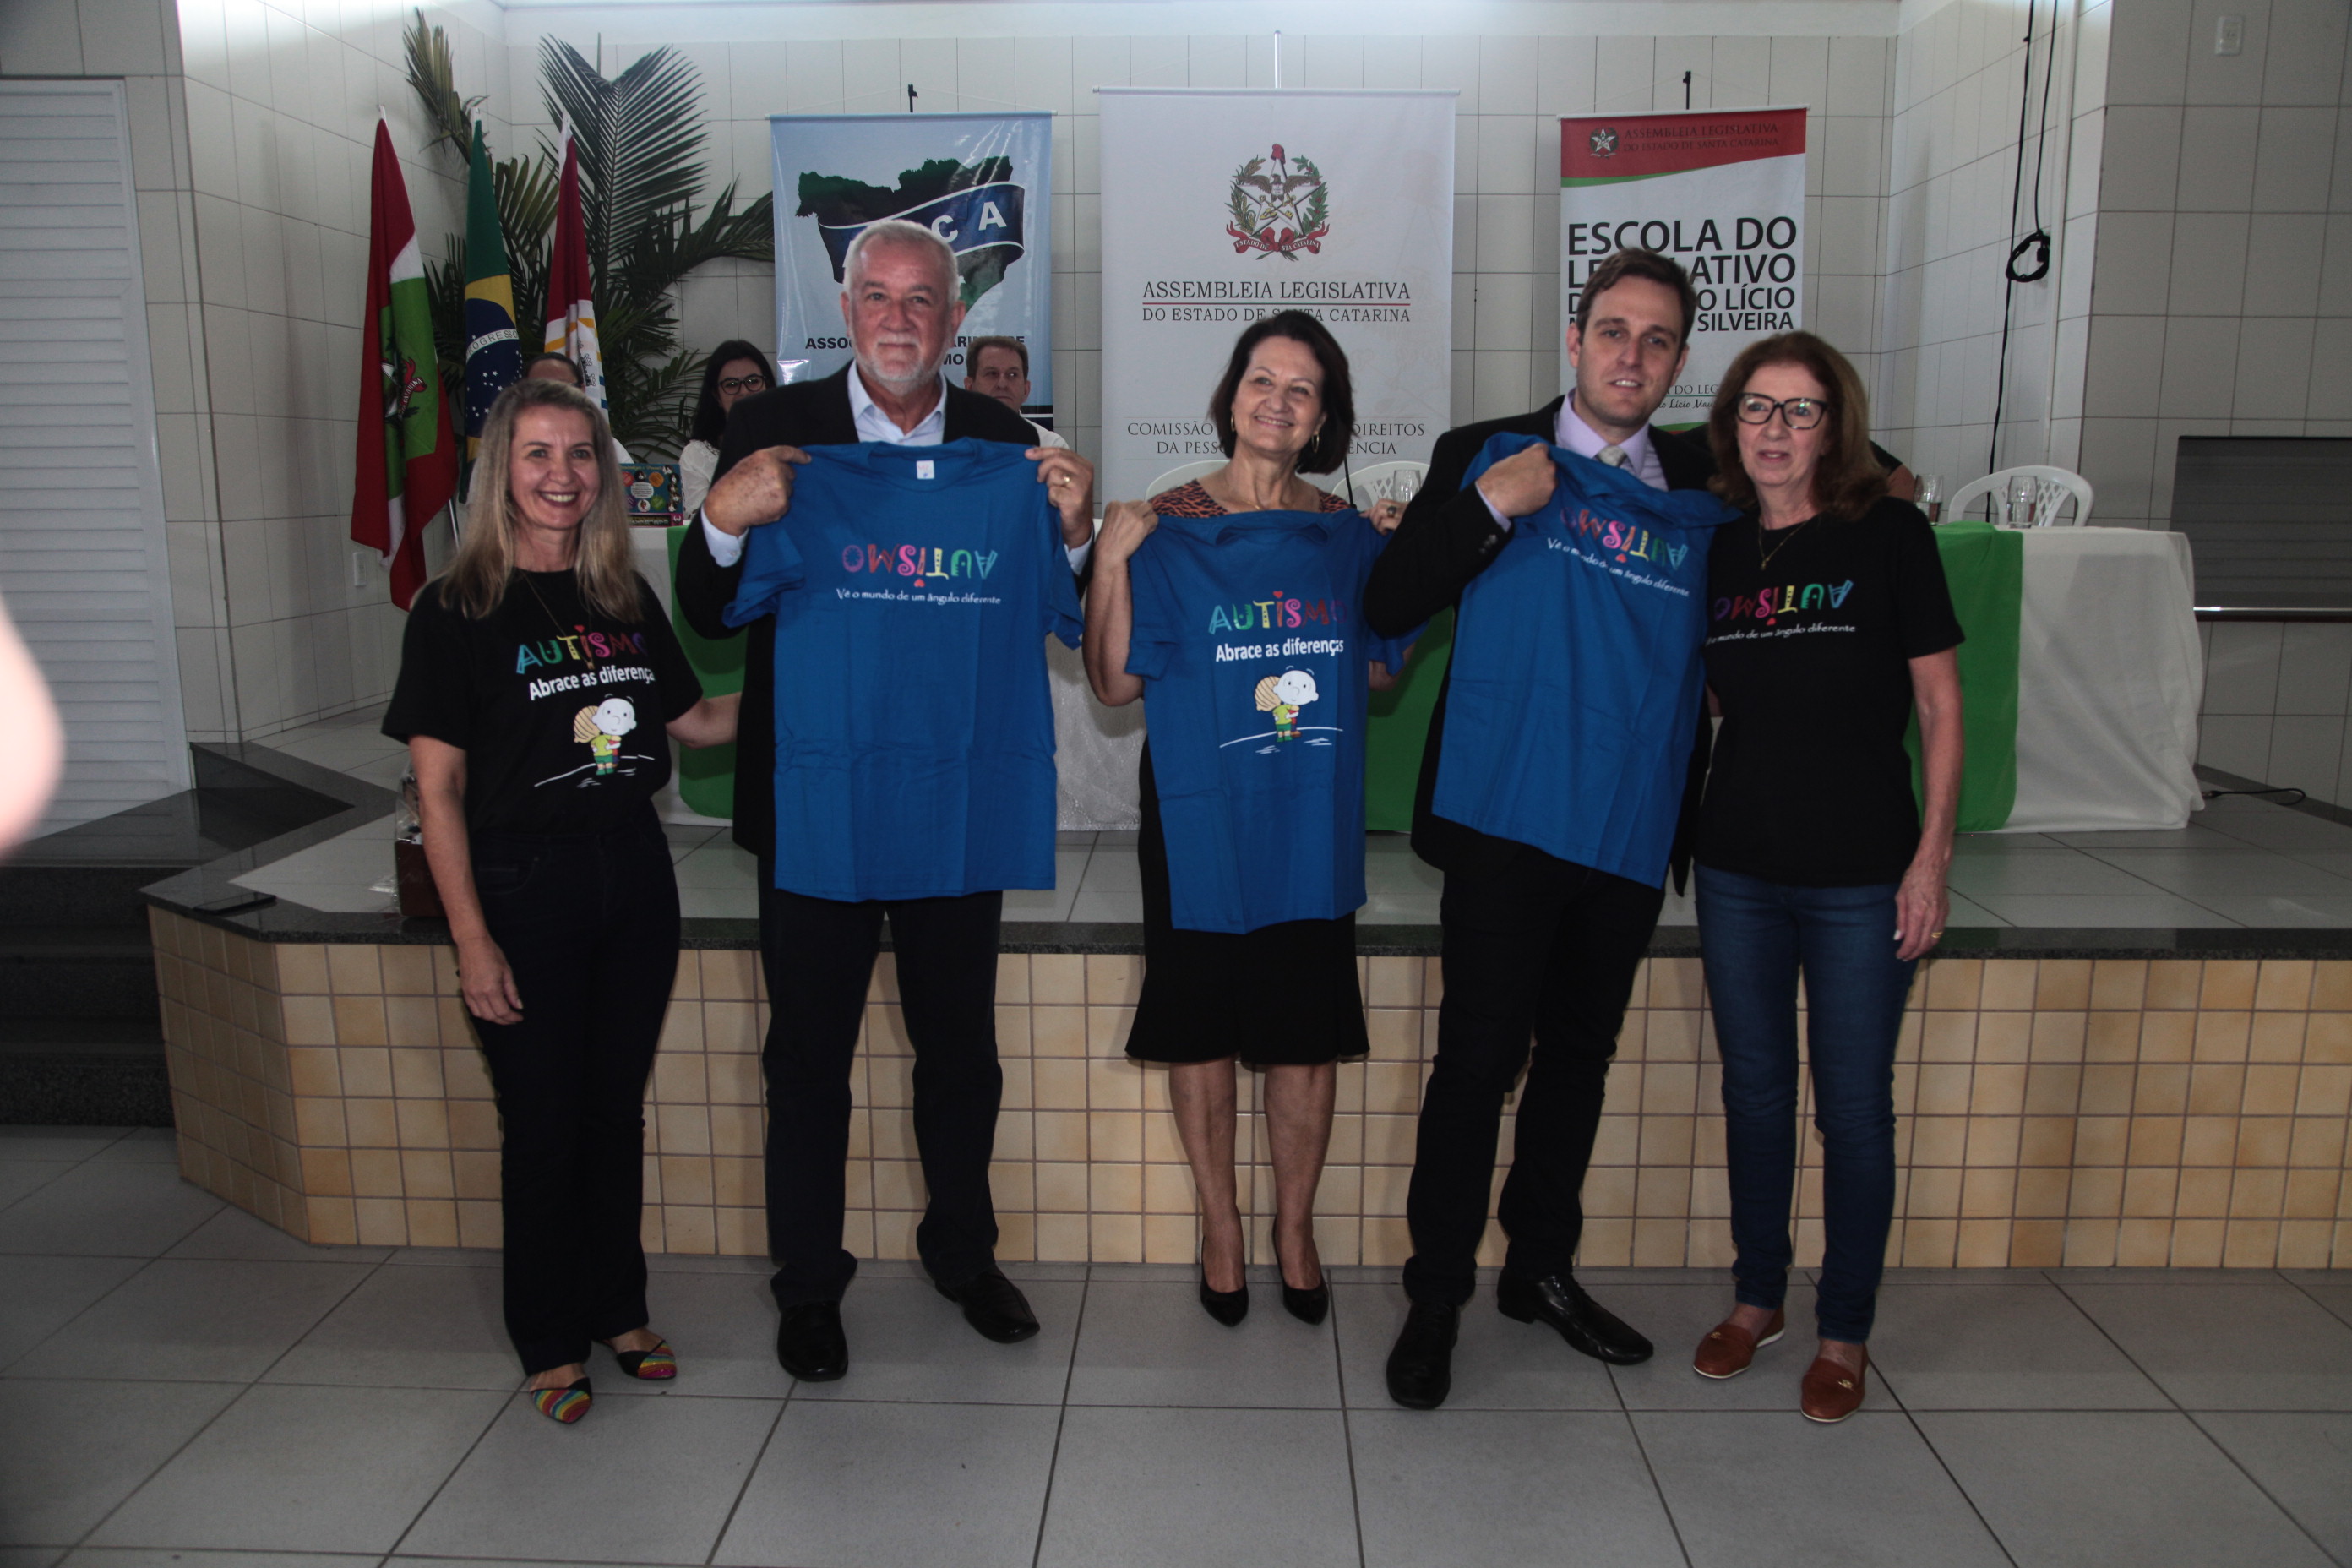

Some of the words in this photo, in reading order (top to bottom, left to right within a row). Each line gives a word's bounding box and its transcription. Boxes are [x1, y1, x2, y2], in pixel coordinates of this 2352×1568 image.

[1625, 128, 1698, 139] ASSEMBLEIA
[1701, 123, 1778, 136] LEGISLATIVA
[1624, 144, 1639, 152] DO
[1642, 142, 1679, 151] ESTADO
[1697, 140, 1729, 149] SANTA
[1568, 219, 1723, 255] ESCOLA
[1736, 216, 1797, 251] DO
[1142, 281, 1274, 299] ASSEMBLEIA
[1280, 281, 1411, 300] LEGISLATIVA
[1725, 284, 1795, 311] LÍCIO
[1142, 308, 1166, 321] DO
[1173, 308, 1238, 322] ESTADO
[1244, 308, 1266, 321] DE
[1272, 308, 1324, 321] STA
[1329, 308, 1411, 322] CATARINA
[1697, 311, 1794, 332] SILVEIRA
[1675, 385, 1693, 395] DO
[1128, 421, 1214, 436] COMISSÃO
[1352, 423, 1424, 436] DIREITOS
[1157, 442, 1179, 454] DA
[862, 589, 896, 600] mundo
[897, 591, 909, 601] de
[961, 593, 1001, 604] diferente
[1807, 622, 1855, 633] diferente
[1216, 643, 1263, 662] Abrace
[1266, 644, 1280, 657] as
[529, 675, 580, 701] Abrace
[582, 672, 598, 687] as
